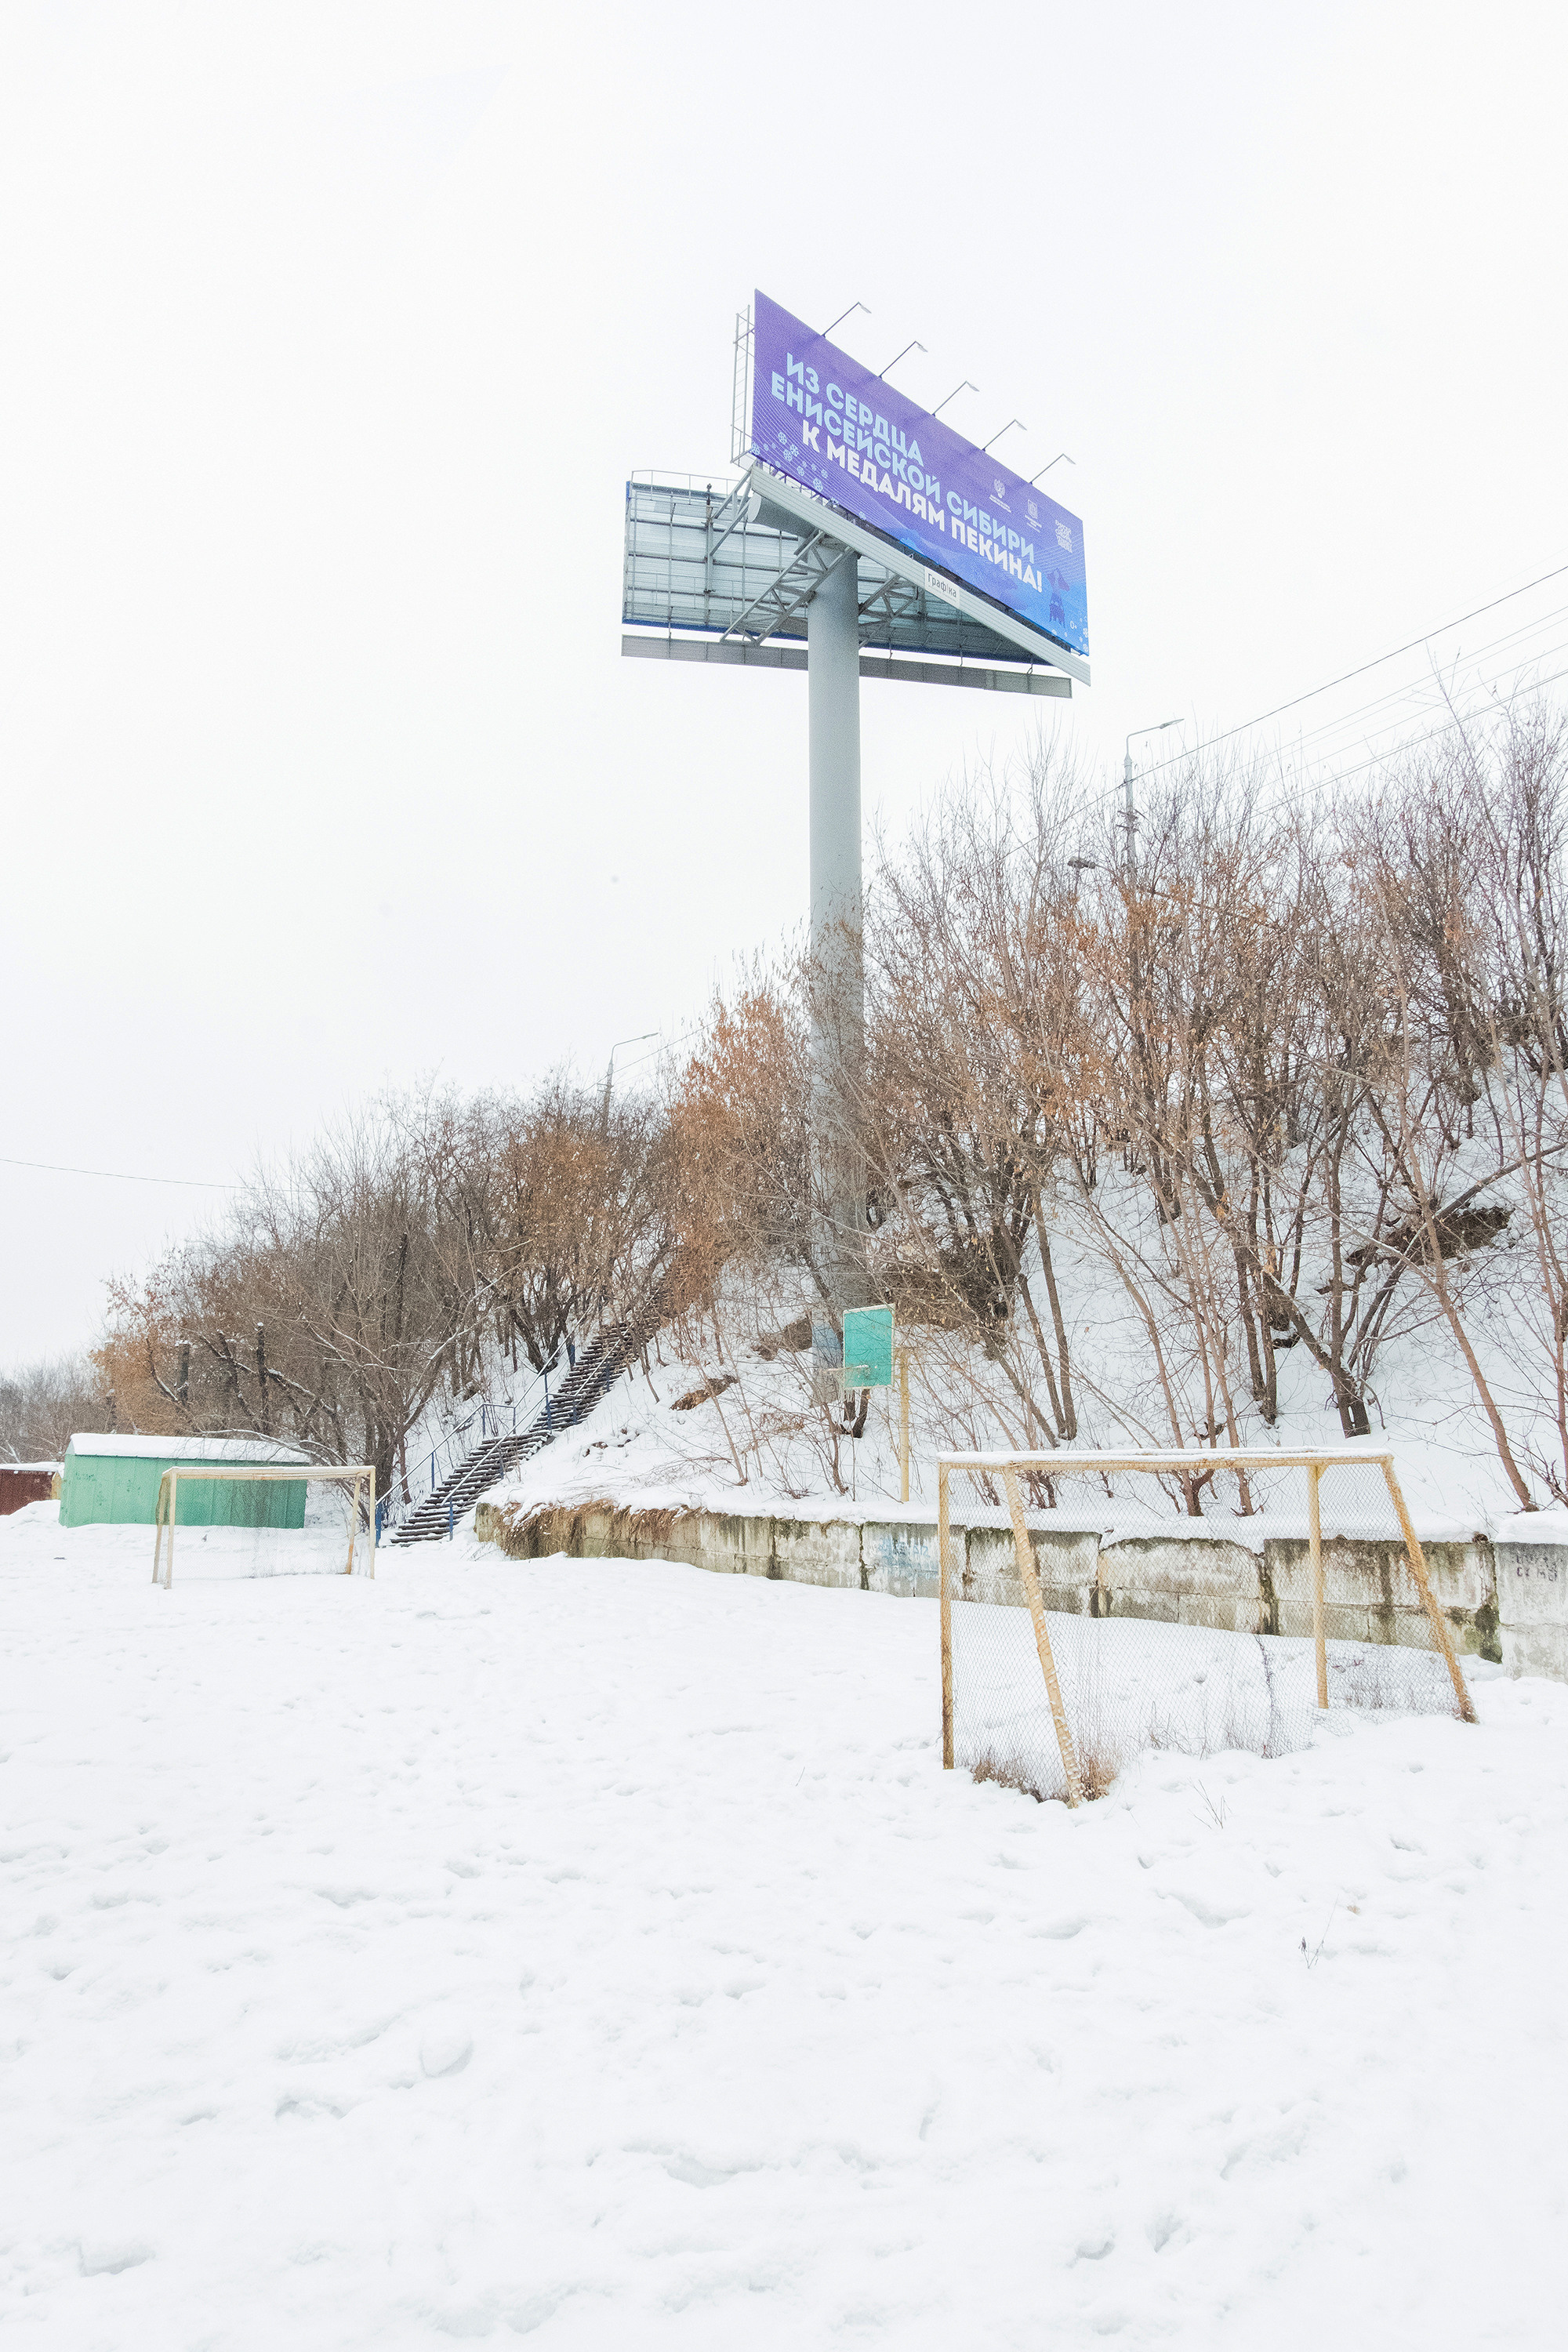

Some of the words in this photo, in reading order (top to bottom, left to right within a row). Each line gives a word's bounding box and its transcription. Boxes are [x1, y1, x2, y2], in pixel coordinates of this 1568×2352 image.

[771, 371, 941, 504] ЕНИСЕЙСКОЙ
[946, 491, 1035, 564] СИБИРИ
[787, 352, 820, 394] ИЗ
[826, 383, 924, 467] СЕРДЦА
[802, 419, 821, 453] К
[826, 435, 945, 532] МЕДАЛЯМ
[951, 516, 1043, 593] ПЕКИНА!
